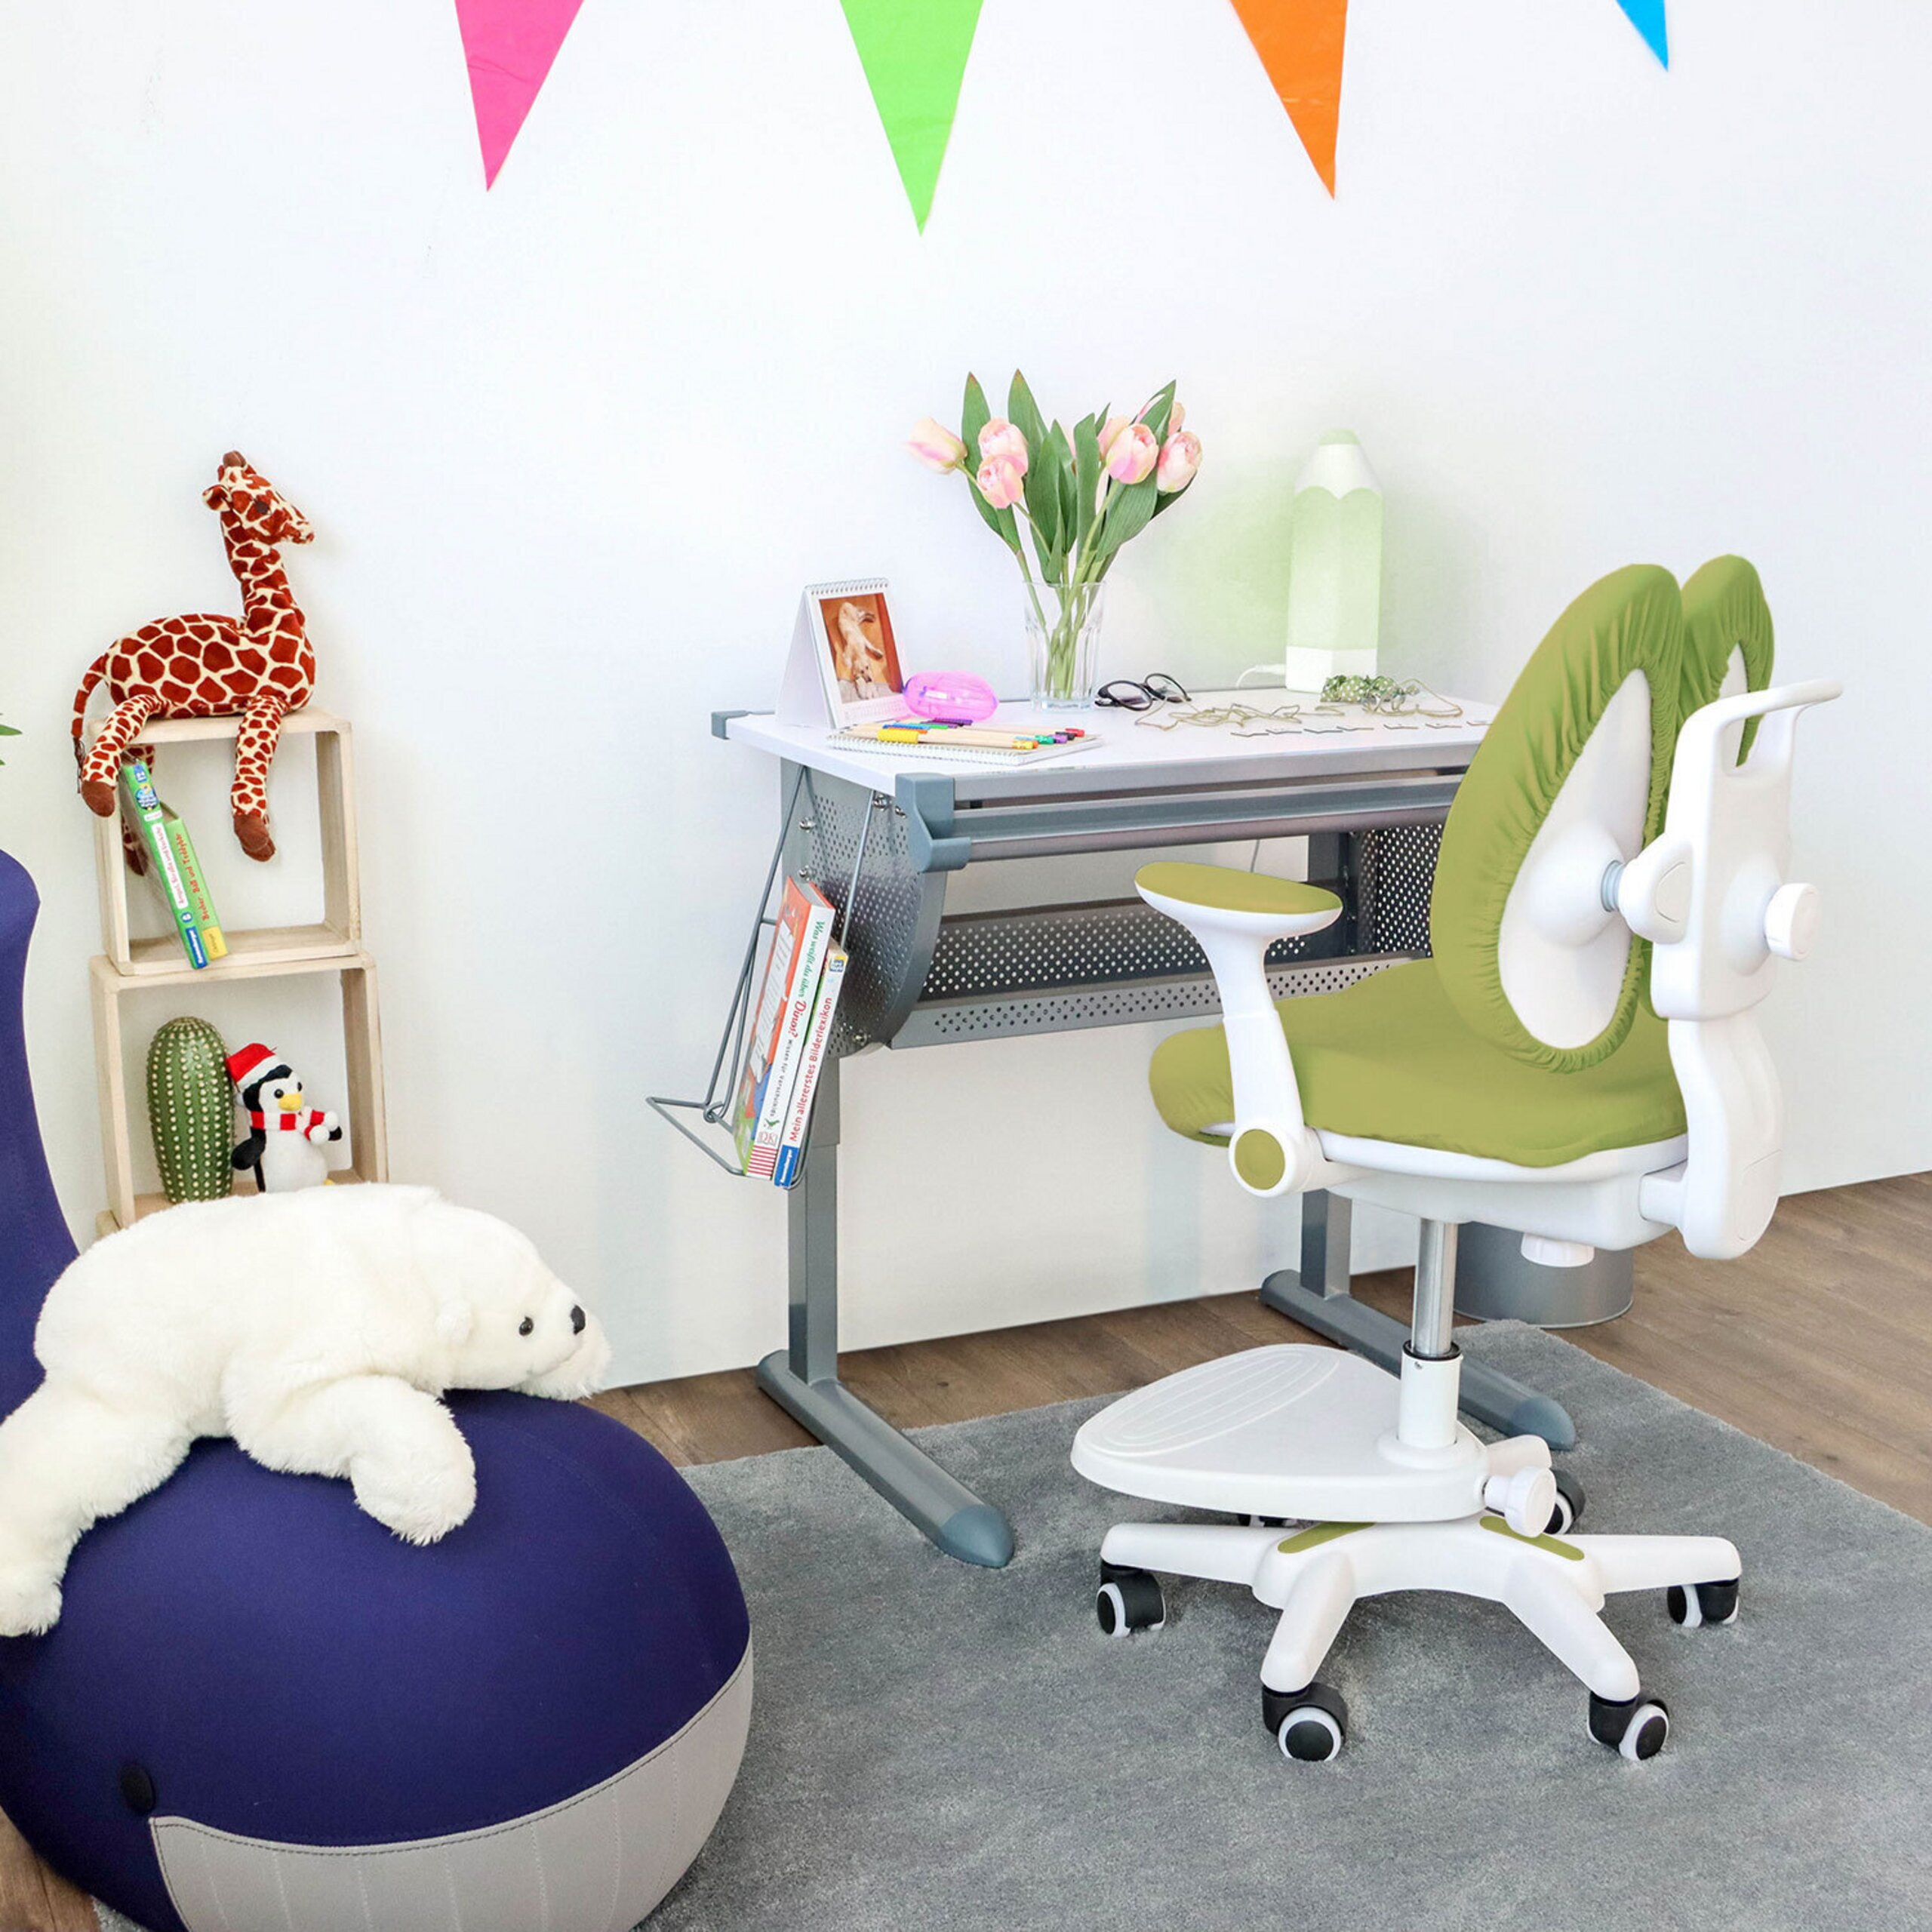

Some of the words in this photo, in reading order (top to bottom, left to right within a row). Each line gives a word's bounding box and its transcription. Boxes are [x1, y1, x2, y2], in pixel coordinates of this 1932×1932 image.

[812, 920, 826, 940] Was
[806, 941, 818, 964] weißt
[803, 962, 814, 977] du
[798, 977, 810, 998] über
[789, 1000, 808, 1038] Dinos?
[789, 1118, 803, 1142] Mein
[797, 1063, 817, 1115] allererstes
[809, 997, 833, 1063] Bilderlexikon
